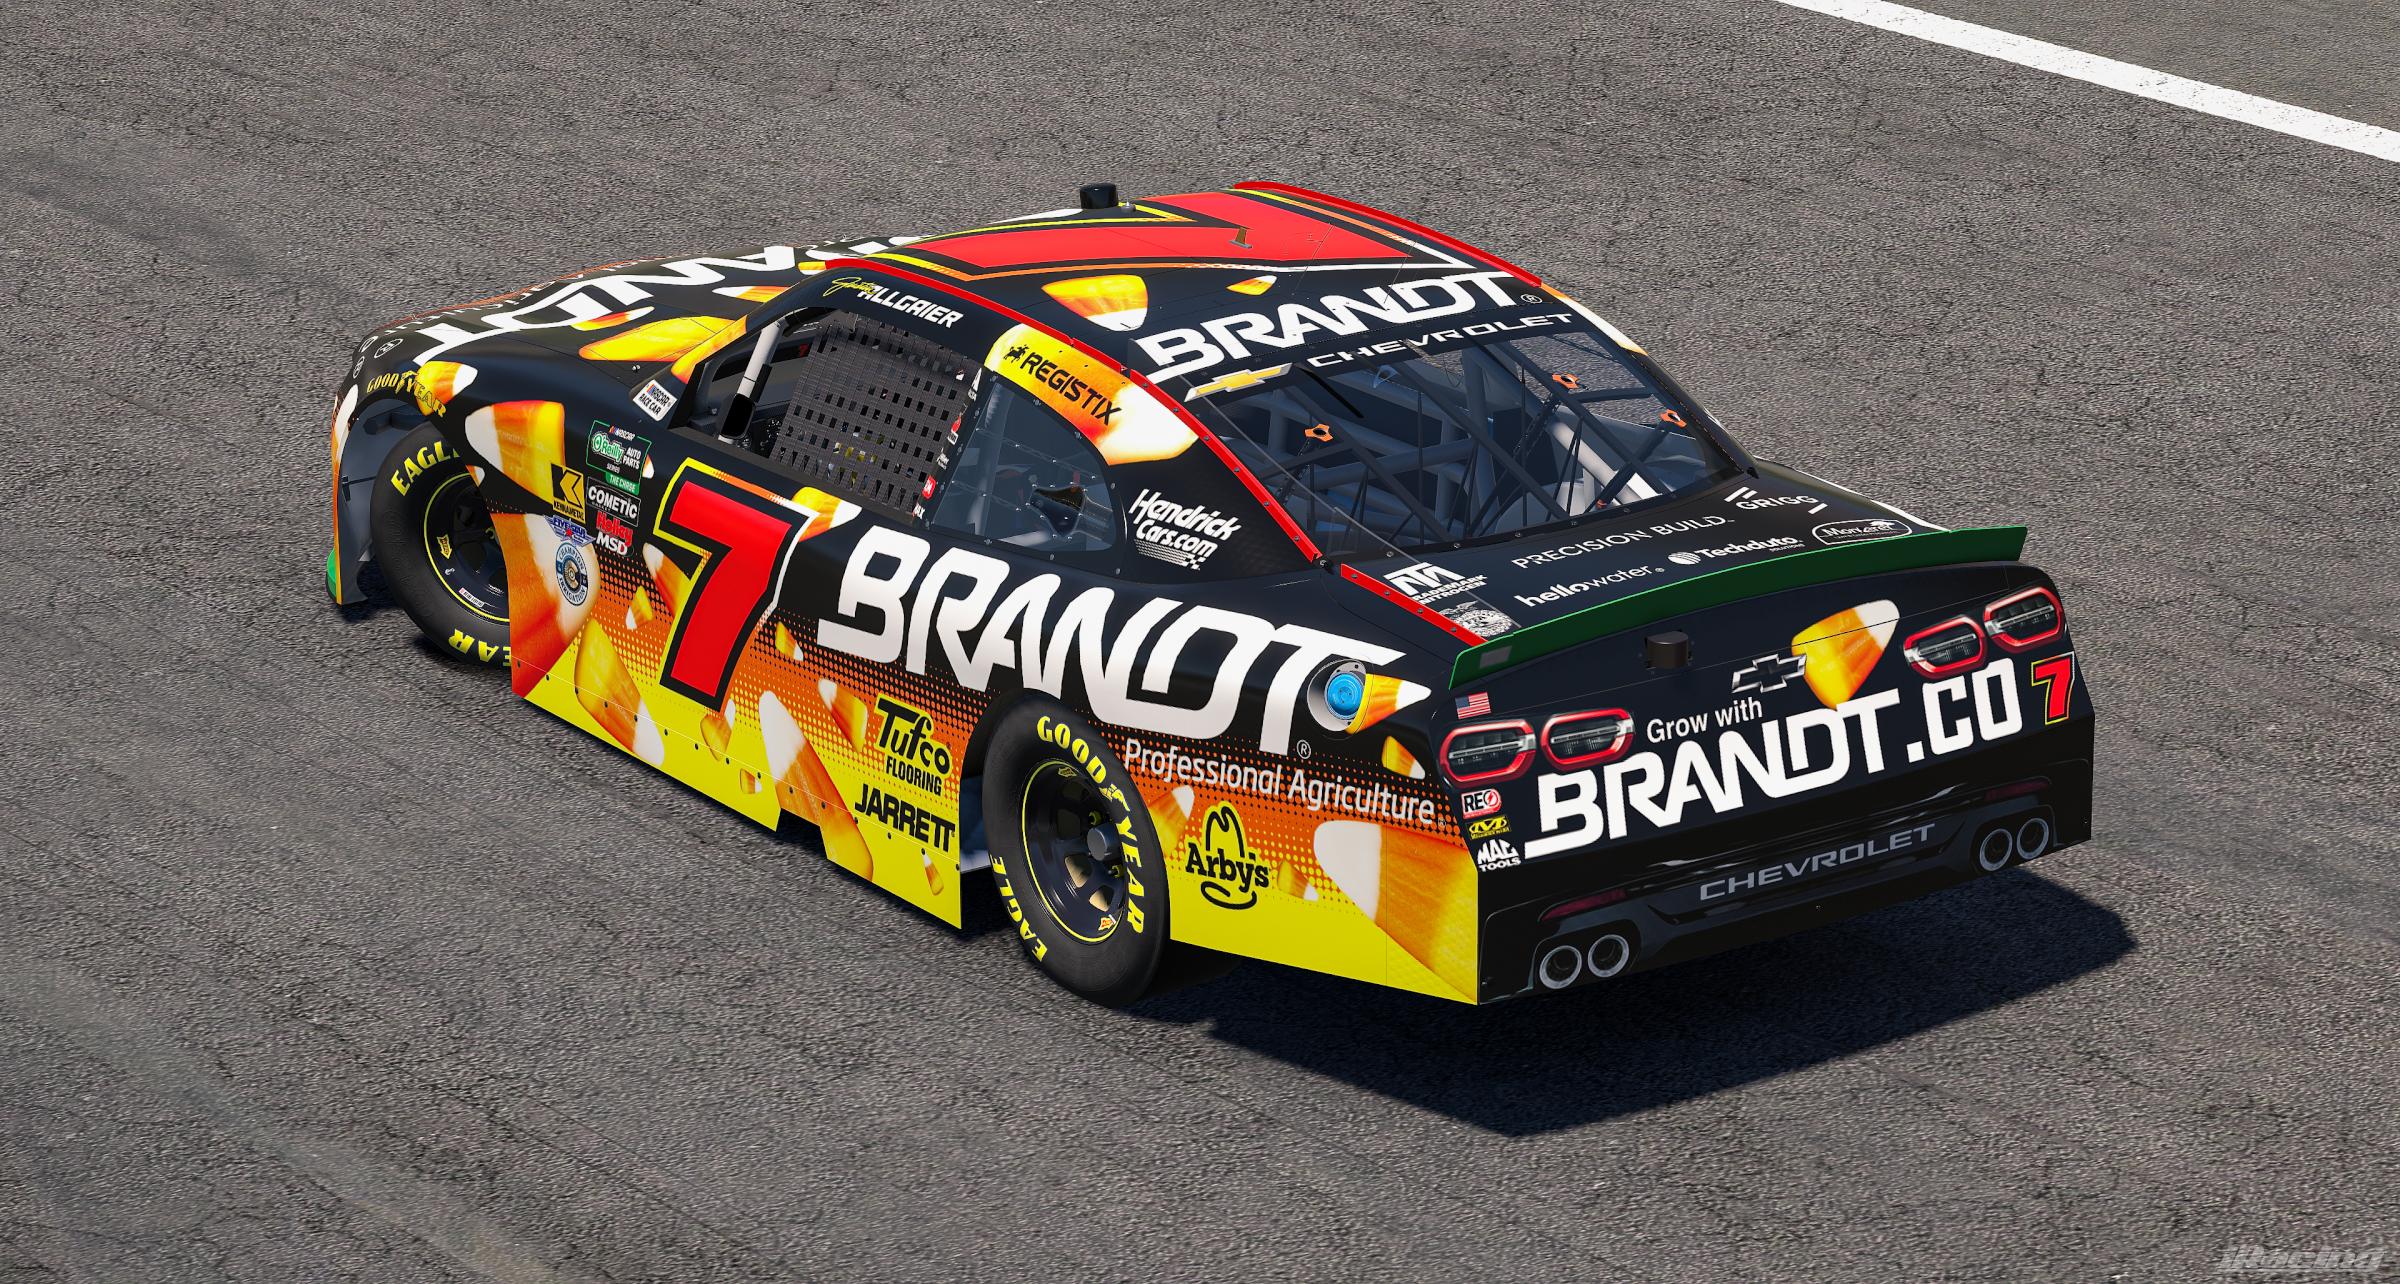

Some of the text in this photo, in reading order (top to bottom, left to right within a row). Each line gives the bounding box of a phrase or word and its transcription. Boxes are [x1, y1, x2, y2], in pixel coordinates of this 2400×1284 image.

[1134, 272, 1518, 384] BRANDT
[1307, 312, 1576, 369] CHEVROLET
[639, 393, 662, 416] RACE CAR
[1019, 352, 1123, 427] REGISTIX
[390, 440, 461, 497] EAGL
[623, 456, 640, 470] PARTS
[626, 446, 642, 460] AUTO
[588, 486, 638, 519] COMETIC
[1128, 488, 1243, 541] Hendrick
[1736, 495, 1819, 511] GRIGG
[596, 510, 634, 547] Holley
[596, 531, 629, 556] MSD
[1135, 519, 1219, 558] Cars.com
[1511, 530, 1653, 569] PRECISION
[1694, 536, 1802, 560] Techduto
[660, 468, 806, 706] 7
[816, 525, 1407, 756] BRANDT
[2031, 652, 2074, 725] 7
[876, 697, 951, 777] Tufco
[1646, 697, 1763, 744] Grow with
[885, 754, 943, 796] FLOORING
[1124, 738, 1436, 825] Professional Agriculture
[854, 784, 956, 853] JARRETT
[1185, 843, 1269, 893] Arby's
[1478, 839, 1520, 865] MAC
[1479, 857, 1522, 873] TOOLS
[1699, 823, 1936, 901] CHEVROLET
[988, 853, 1048, 963] EAGLE
